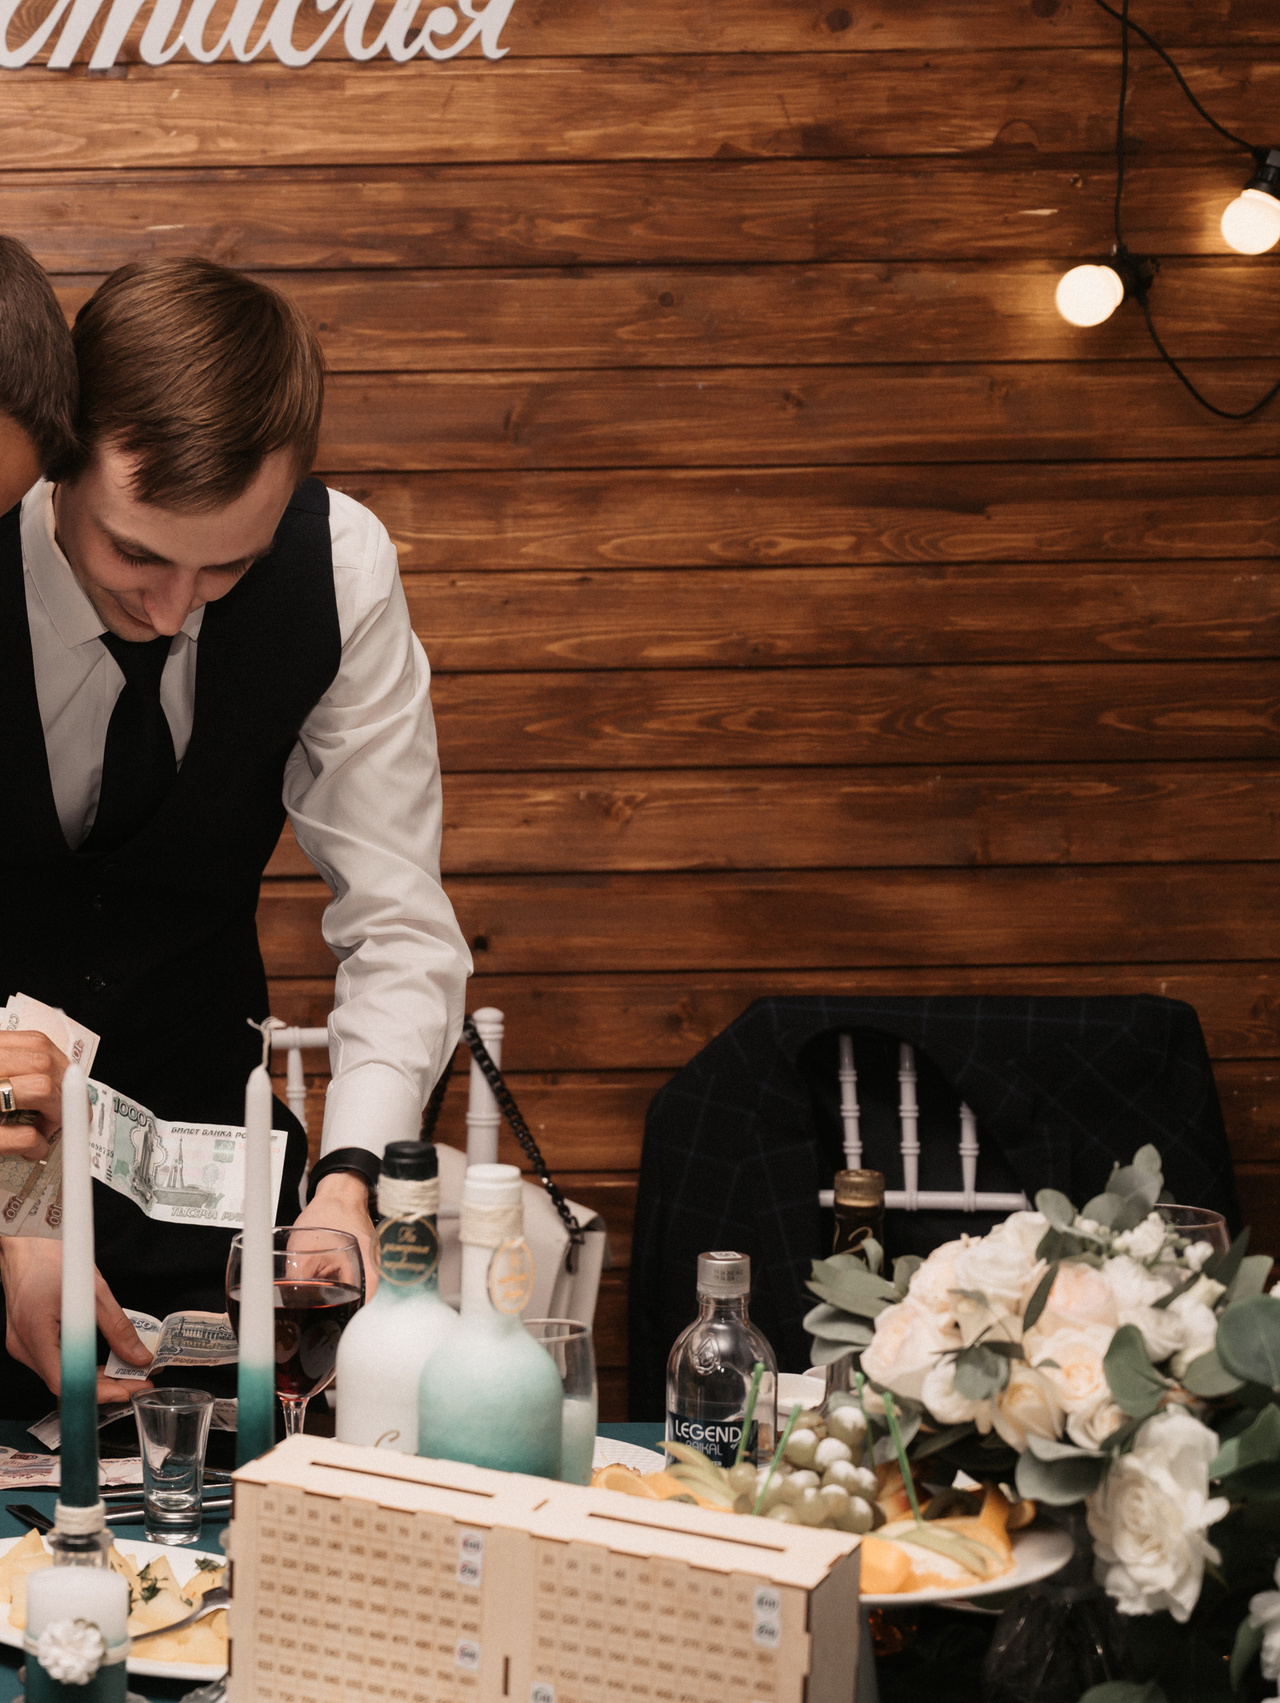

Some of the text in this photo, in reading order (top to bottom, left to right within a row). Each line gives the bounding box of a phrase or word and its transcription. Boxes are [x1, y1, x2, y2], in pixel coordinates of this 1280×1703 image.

[113, 1096, 148, 1128] 1000
[202, 1129, 232, 1138] БАНКА
[675, 1420, 742, 1443] LEGEND
